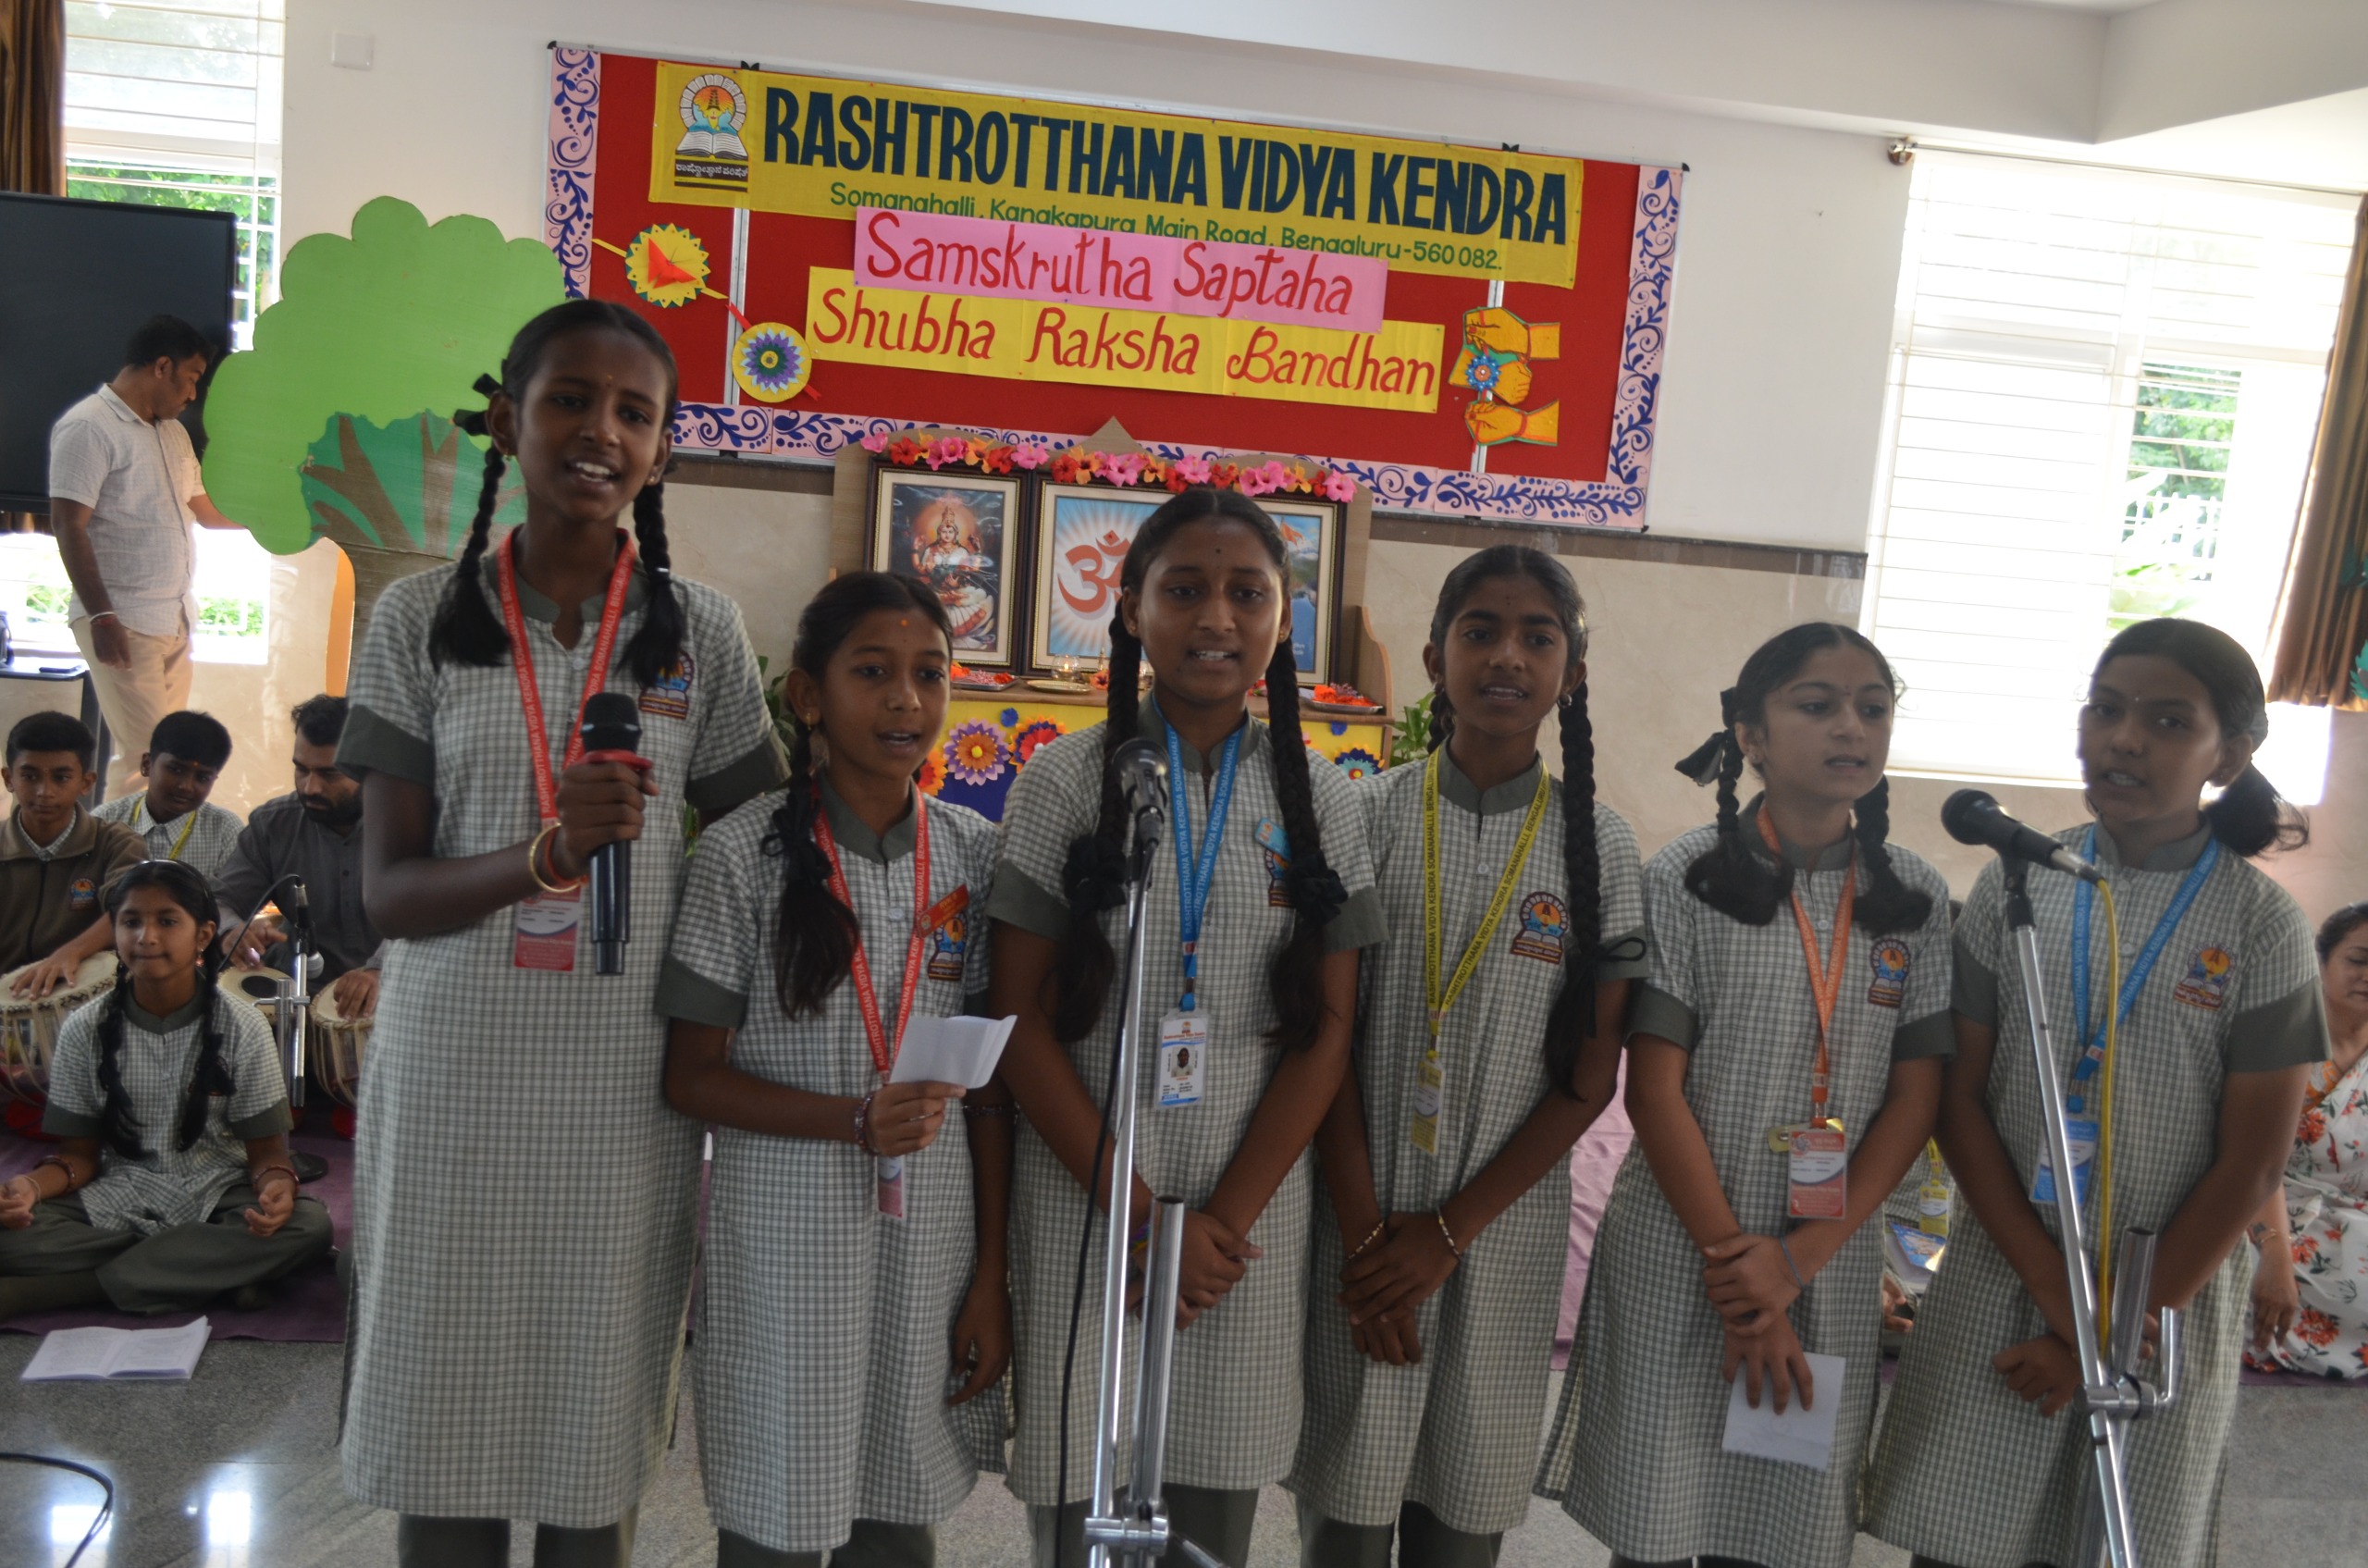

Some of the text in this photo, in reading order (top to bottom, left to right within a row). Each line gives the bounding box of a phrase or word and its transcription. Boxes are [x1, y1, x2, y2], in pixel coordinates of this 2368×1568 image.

[763, 86, 1567, 246] RASHTROTTHANA VIDYA KENDRA
[1146, 214, 1199, 241] Main
[868, 211, 1353, 318] Samskrutha Saptaha
[813, 288, 1436, 397] Shubha Raksha Bandhan
[519, 667, 534, 702] KENDRA
[525, 703, 539, 732] VIDYA
[531, 734, 551, 813] RASHTROTTHANA
[1176, 795, 1188, 829] KENDRA
[1204, 832, 1215, 857] VIDYA
[1212, 799, 1225, 831] KENDRA
[1178, 831, 1189, 855] VIDYA
[1428, 906, 1437, 931] VIDYA
[1428, 932, 1437, 1004] RASHTROTTHANA
[1445, 940, 1483, 1006] RASHTROTTHANA
[1478, 916, 1494, 940] VIDYA
[1490, 886, 1509, 917] KENDRA
[856, 963, 869, 989] VIDYA
[906, 957, 917, 983] VIDYA
[862, 990, 885, 1066] RASHTROTTHANA
